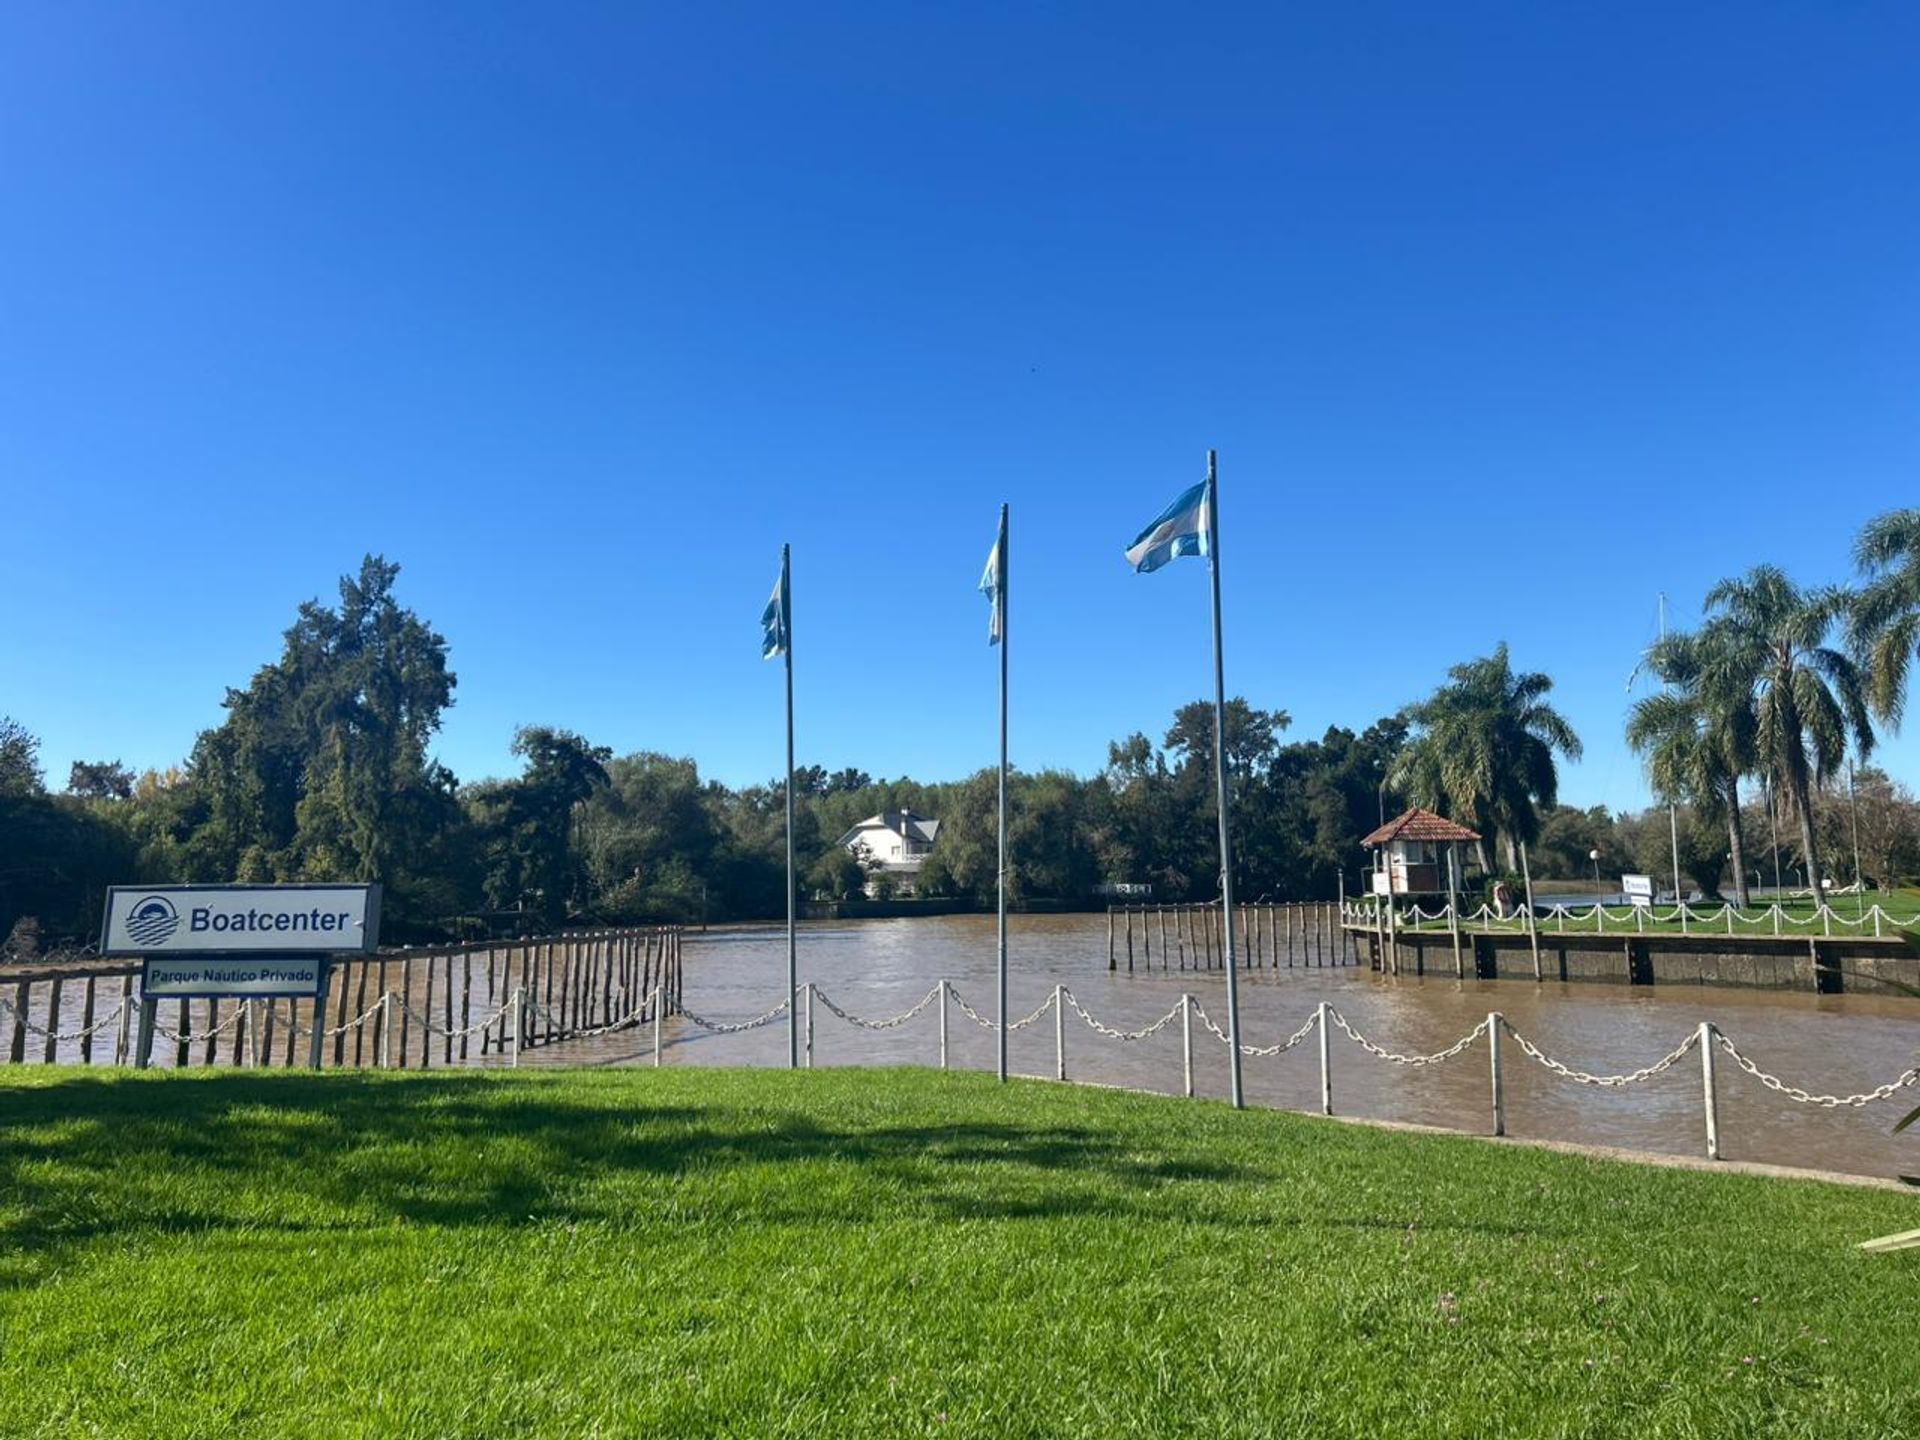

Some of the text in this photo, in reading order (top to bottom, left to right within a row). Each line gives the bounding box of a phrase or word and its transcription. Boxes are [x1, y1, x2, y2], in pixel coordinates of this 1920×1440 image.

[190, 907, 349, 932] Boatcenter
[151, 970, 200, 984] Parque
[260, 969, 314, 982] Privado
